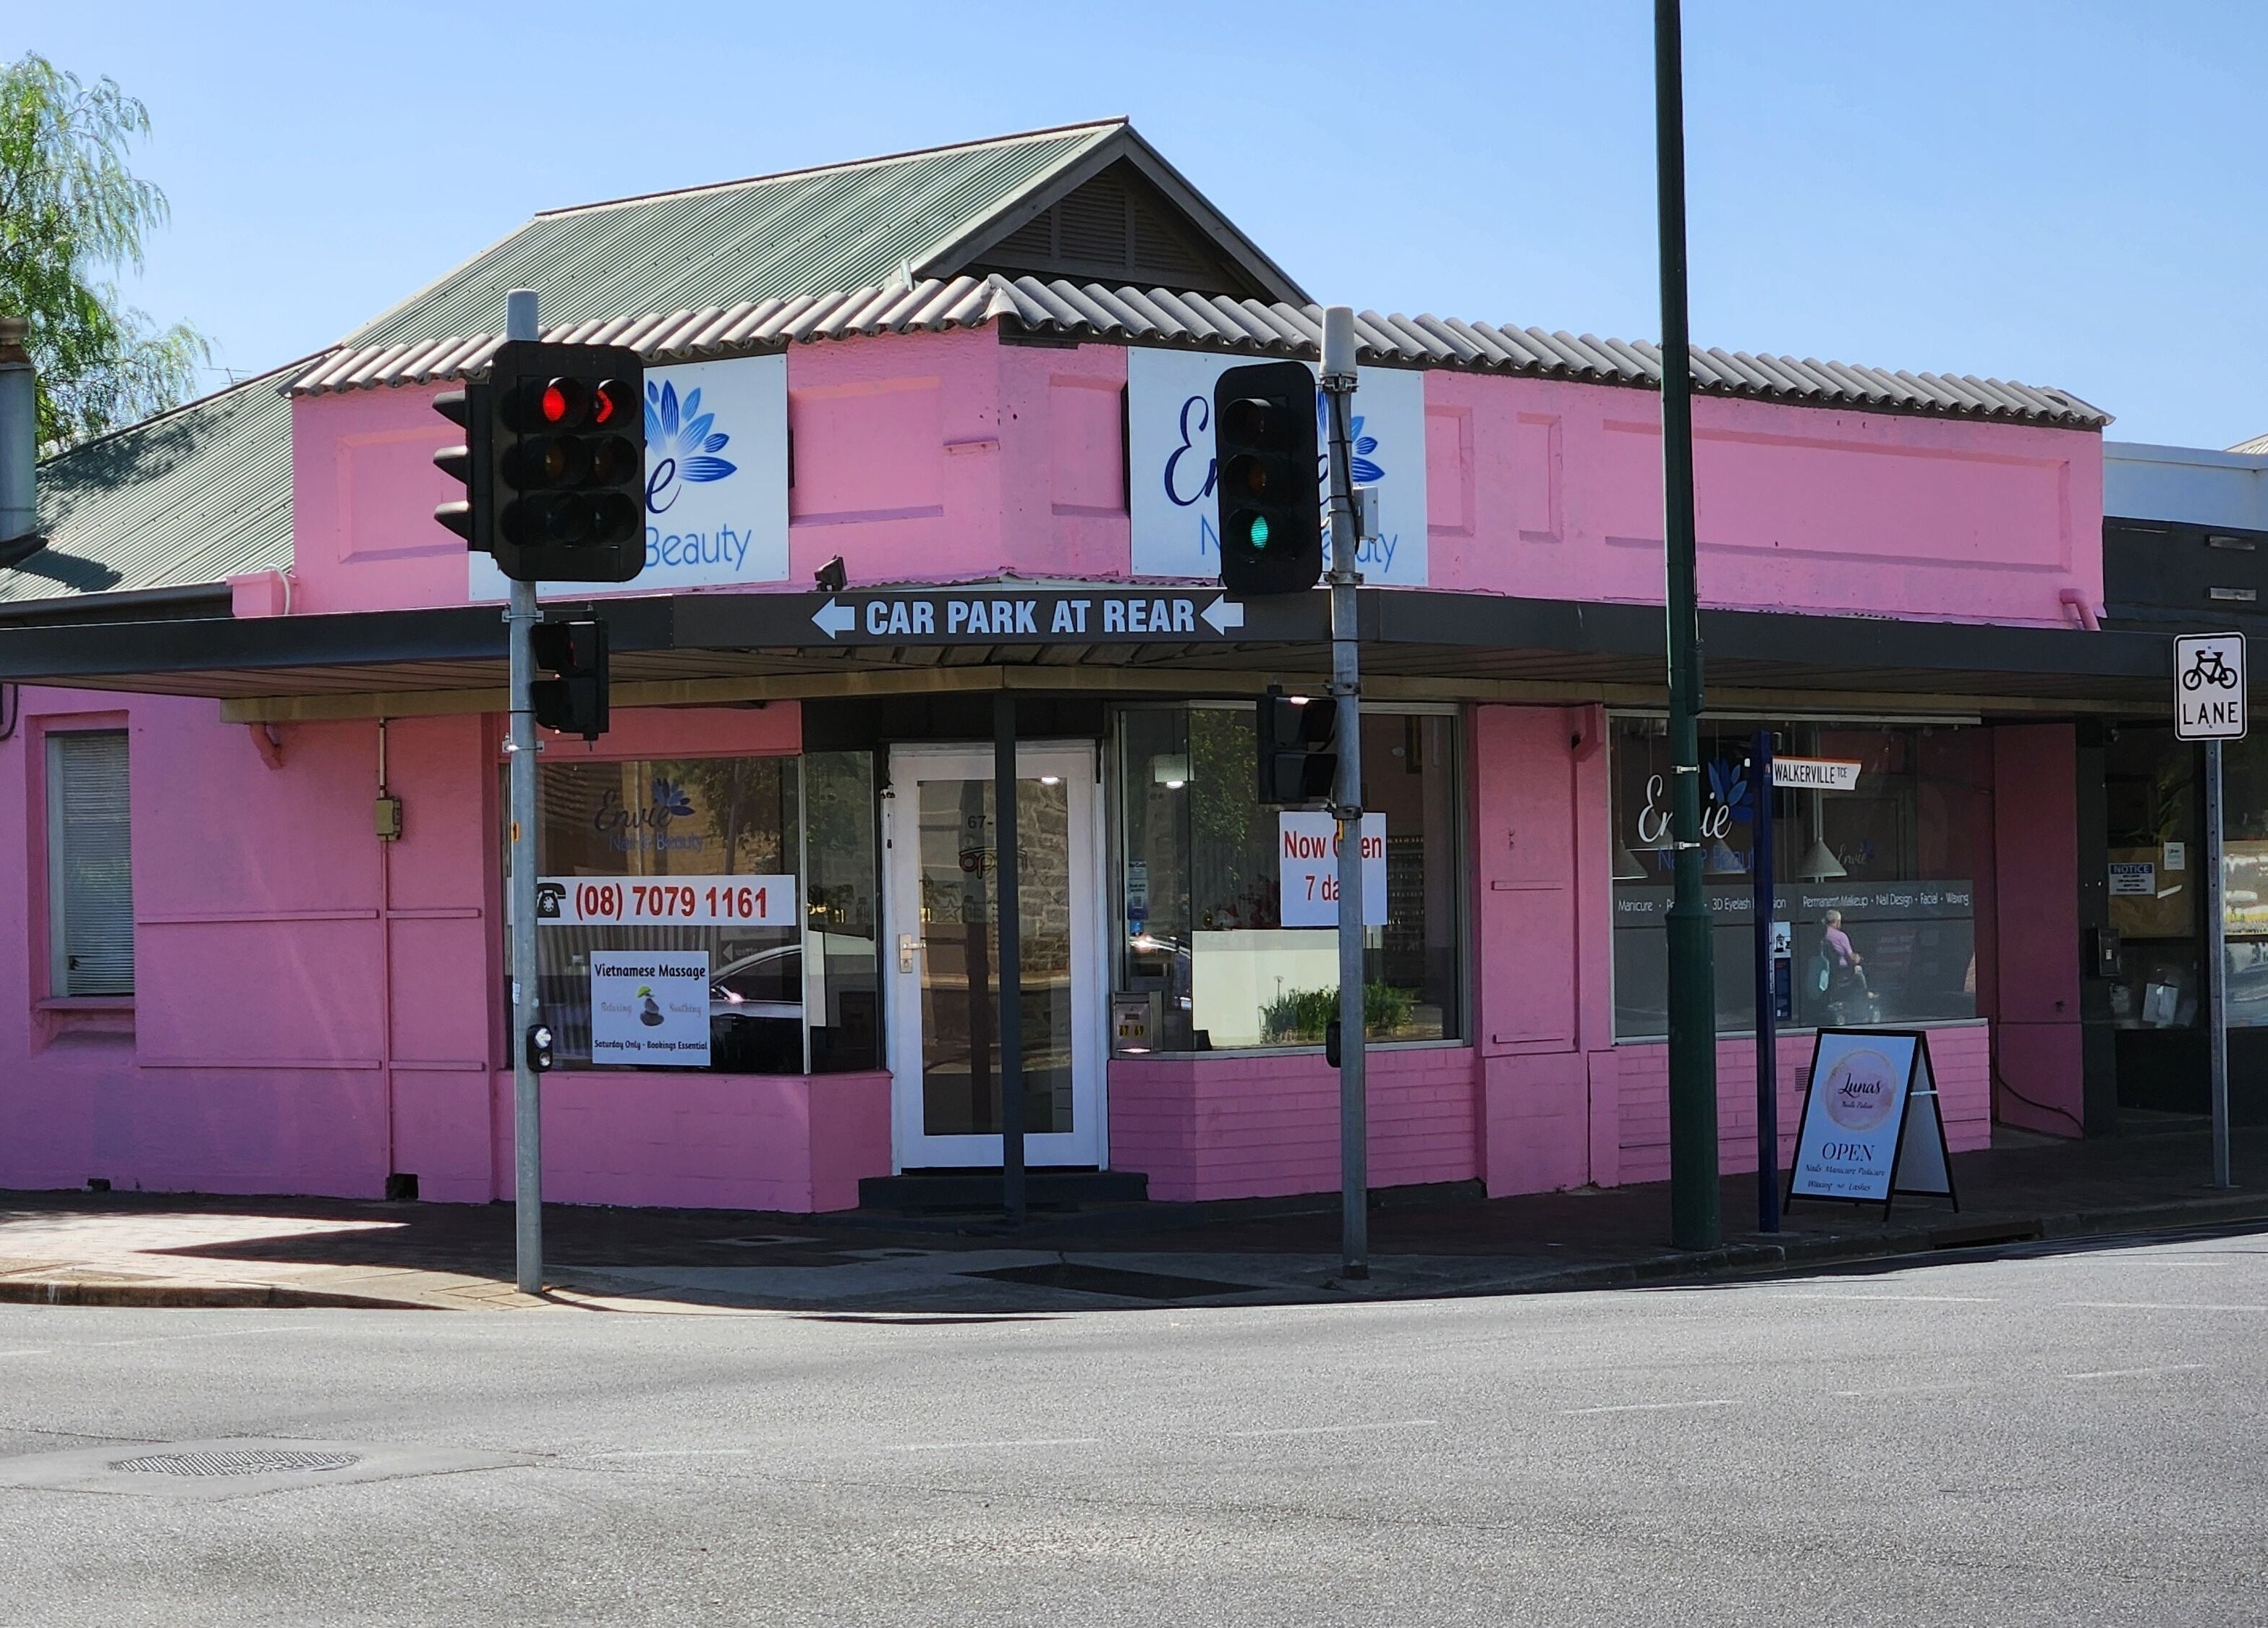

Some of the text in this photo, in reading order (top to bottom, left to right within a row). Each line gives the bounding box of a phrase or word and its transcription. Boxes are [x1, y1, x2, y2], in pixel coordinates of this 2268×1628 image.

[867, 598, 1194, 634] CAR PARK AT REAR
[2183, 702, 2238, 725] LANE
[1775, 763, 1848, 784] WALKERVILLE TCE
[595, 789, 673, 831] Envie
[656, 833, 702, 854] Beauty
[1284, 831, 1326, 859] Now
[2113, 865, 2150, 873] NOTICE
[1305, 875, 1316, 901] 7
[576, 882, 766, 921] (08) 7079 1161
[1618, 899, 1653, 912] Manicure
[1712, 898, 1723, 911] 3D
[1724, 897, 1751, 912] Eyelash
[1876, 893, 1889, 906] Nail
[1890, 893, 1914, 907] Design
[1920, 892, 1938, 904] Facial
[1945, 892, 1970, 907] Waxing
[594, 962, 706, 981] Vietnamese Massage
[1134, 1025, 1144, 1037] 69
[594, 1040, 624, 1051] Saturday
[625, 1040, 641, 1051] Only
[647, 1040, 676, 1051] Bookings
[678, 1041, 708, 1050] Essential
[1838, 1072, 1882, 1098] Lunas
[1822, 1142, 1875, 1162] OPEN
